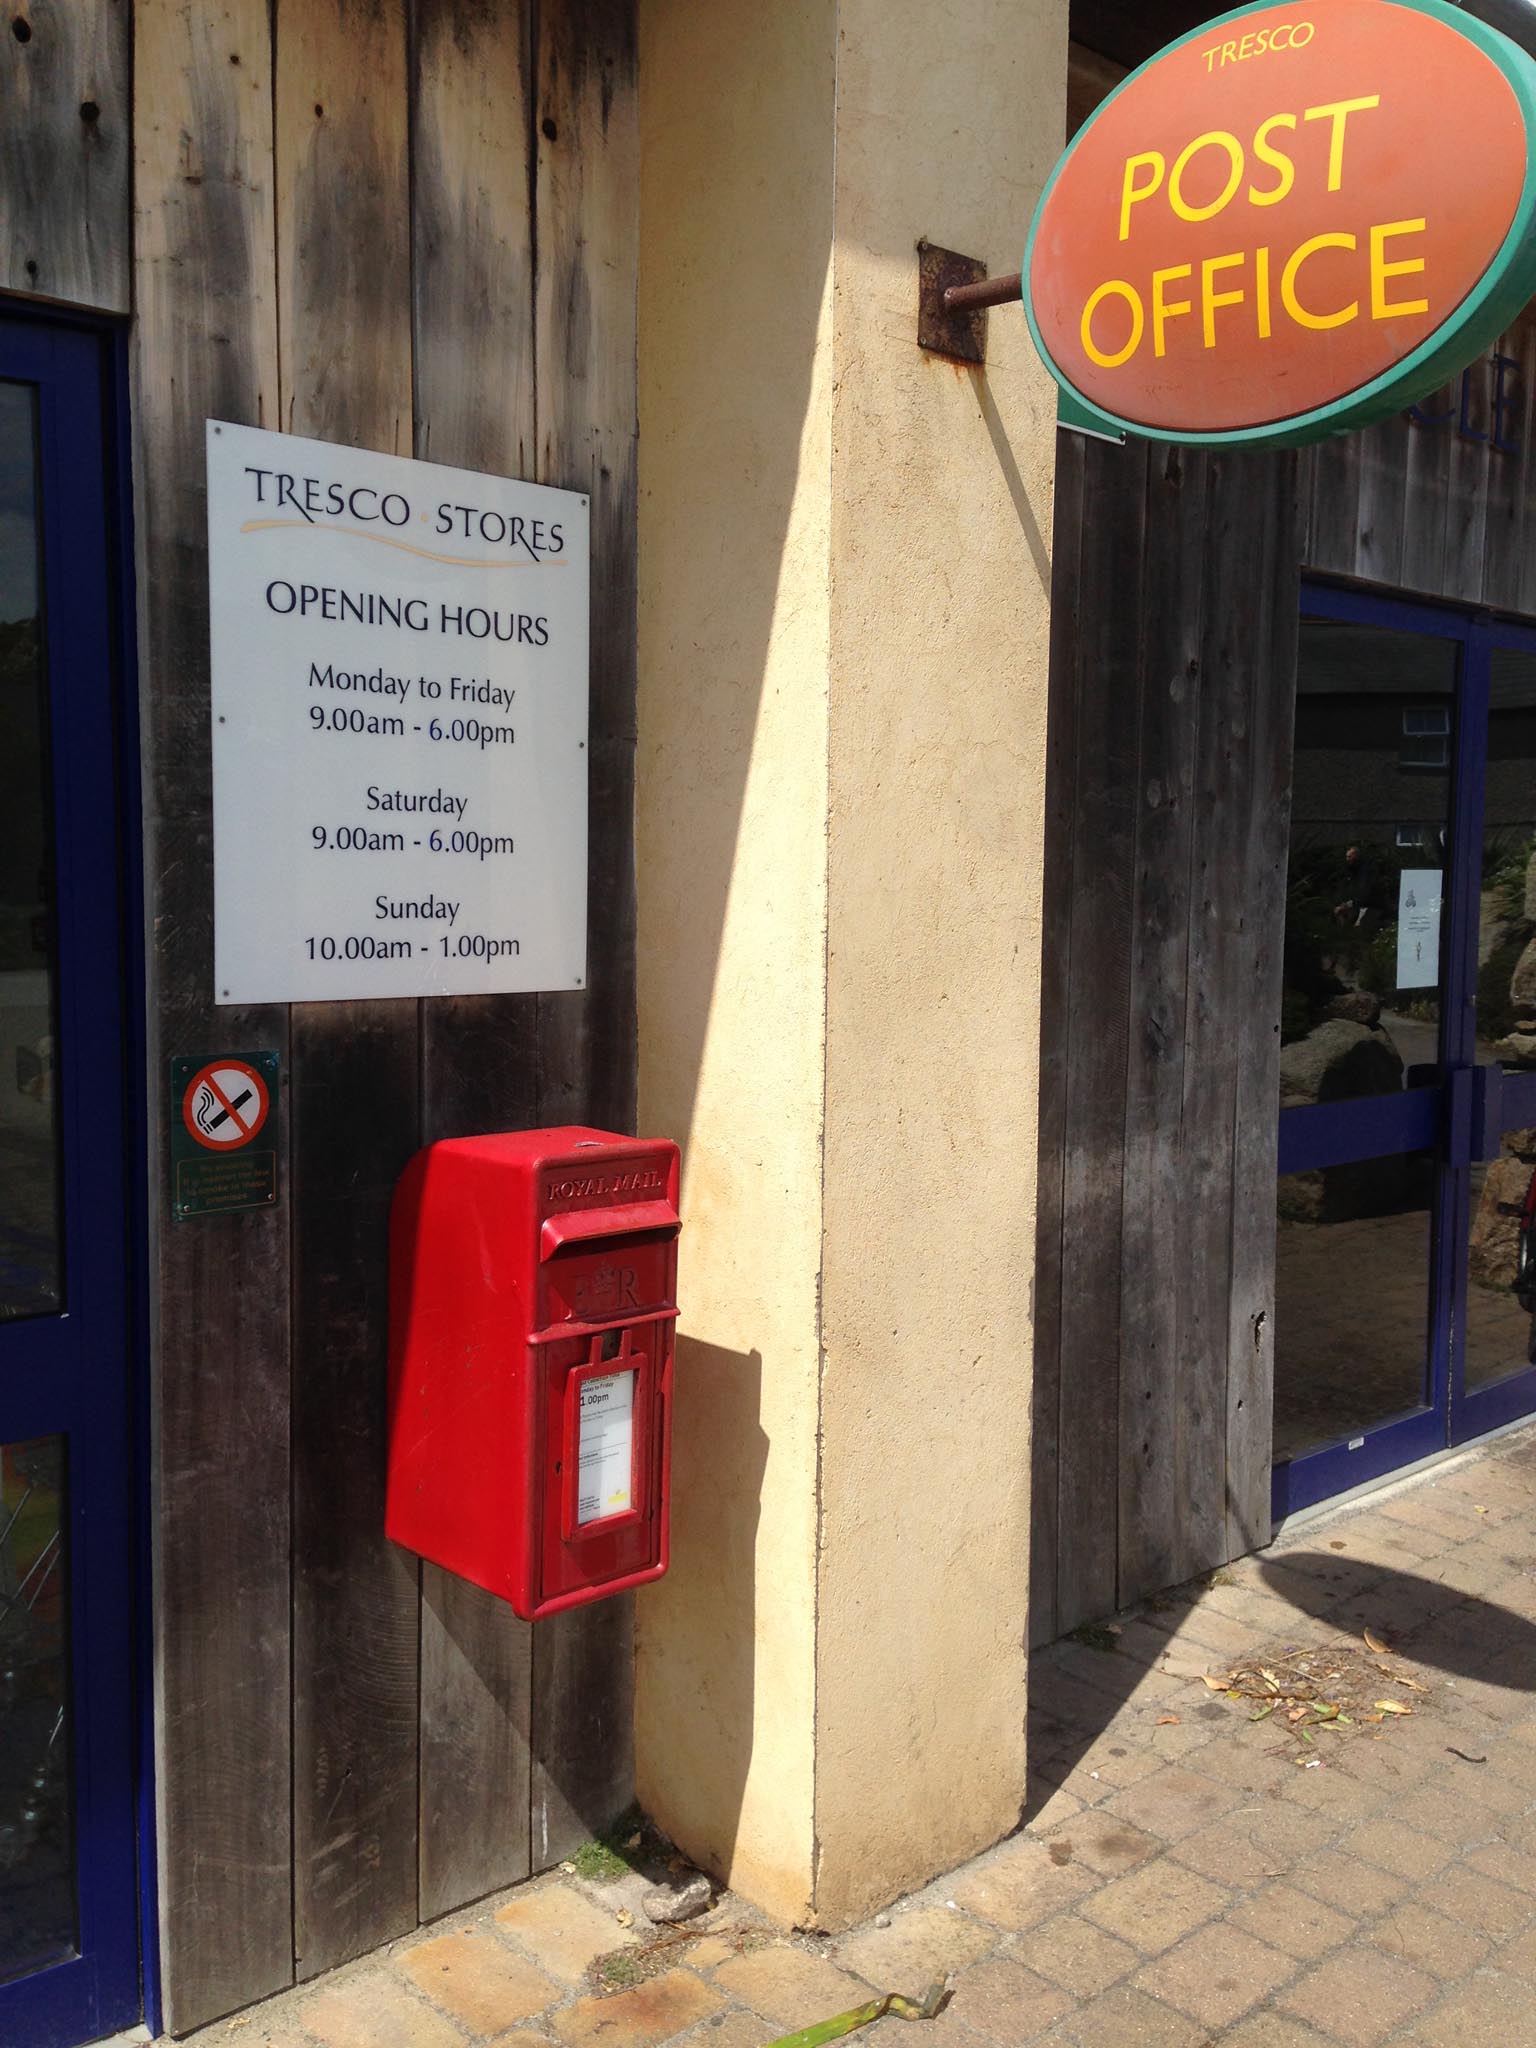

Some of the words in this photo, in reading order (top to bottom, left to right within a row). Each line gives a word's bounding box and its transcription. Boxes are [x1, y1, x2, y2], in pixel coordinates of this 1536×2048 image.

[1202, 22, 1315, 73] TRESCO
[1119, 95, 1380, 241] POST
[1080, 217, 1429, 368] OFFICE
[245, 467, 410, 525] TRESCO
[436, 503, 564, 562] STORES
[266, 580, 428, 631] OPENING
[441, 603, 550, 646] HOURS
[308, 662, 410, 704] Monday
[419, 676, 442, 699] to
[450, 677, 516, 713] Friday
[310, 705, 404, 735] 9.00am
[429, 718, 515, 750] 6.00pm
[367, 786, 468, 822] Saturday
[312, 826, 404, 851] 9.00am
[429, 829, 514, 861] 6.00pm
[375, 894, 460, 927] Sunday
[305, 936, 412, 960] 10.00am
[439, 935, 520, 964] 1.00pm
[549, 1178, 609, 1200] ROYAL
[613, 1171, 662, 1192] MAIL
